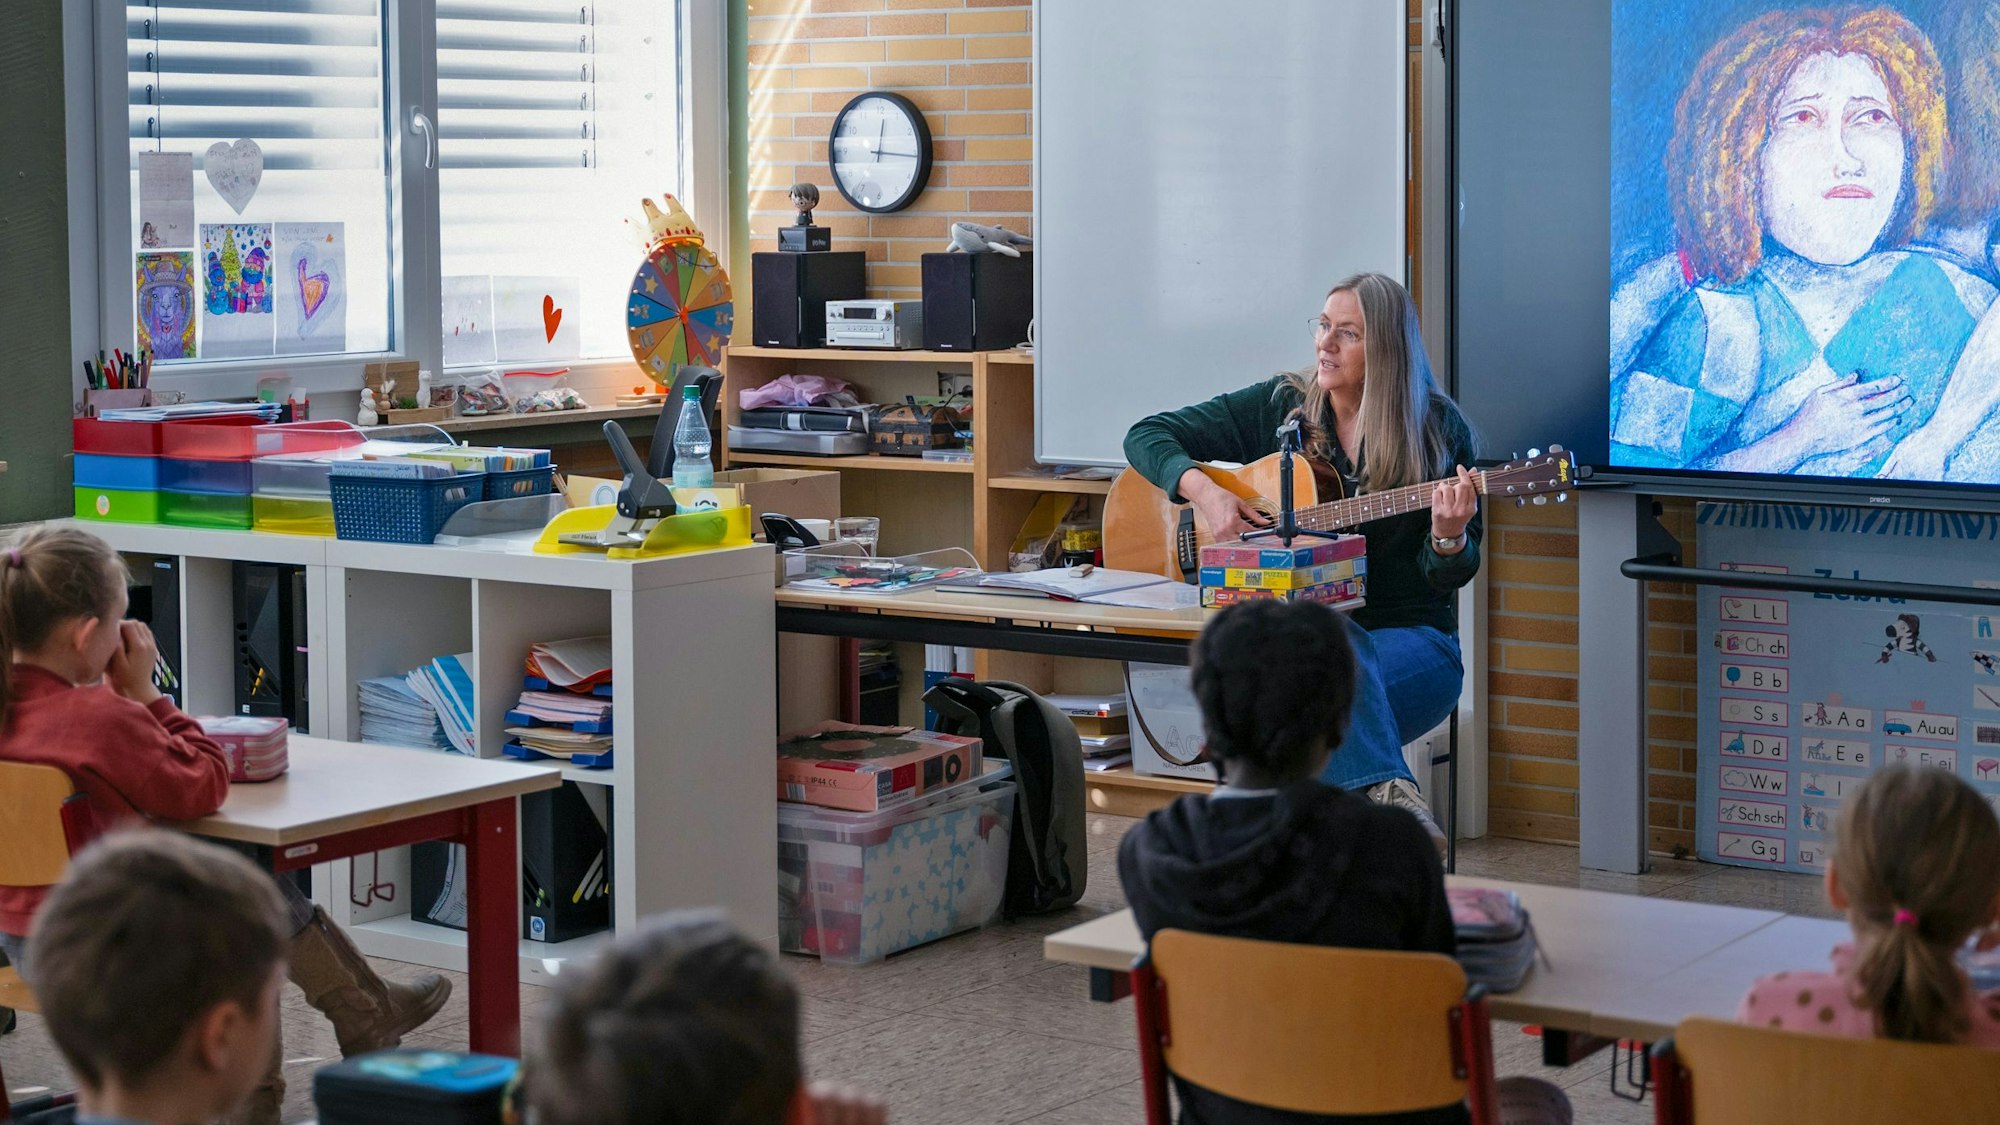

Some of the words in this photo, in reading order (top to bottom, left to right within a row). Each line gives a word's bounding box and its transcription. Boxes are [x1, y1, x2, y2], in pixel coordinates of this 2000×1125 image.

[876, 106, 885, 115] 12
[849, 127, 857, 135] 10
[1754, 604, 1761, 619] L
[1745, 637, 1764, 653] Ch
[1770, 640, 1785, 654] ch
[1753, 672, 1763, 687] B
[1773, 673, 1782, 688] b
[1754, 705, 1763, 721] S
[1772, 711, 1779, 722] s
[1837, 711, 1850, 727] A
[1856, 718, 1865, 728] a
[1917, 720, 1936, 735] Au
[1938, 725, 1954, 736] au
[1753, 740, 1764, 755] D
[1772, 741, 1781, 756] d
[1837, 745, 1845, 760] E
[1855, 753, 1864, 762] e
[1939, 756, 1952, 770] ei
[811, 777, 826, 786] IP44
[1750, 773, 1768, 789] W
[1771, 782, 1782, 791] w
[1738, 806, 1761, 822] Sch
[1764, 811, 1784, 825] sch
[1751, 840, 1765, 856] G
[1769, 846, 1778, 862] g
